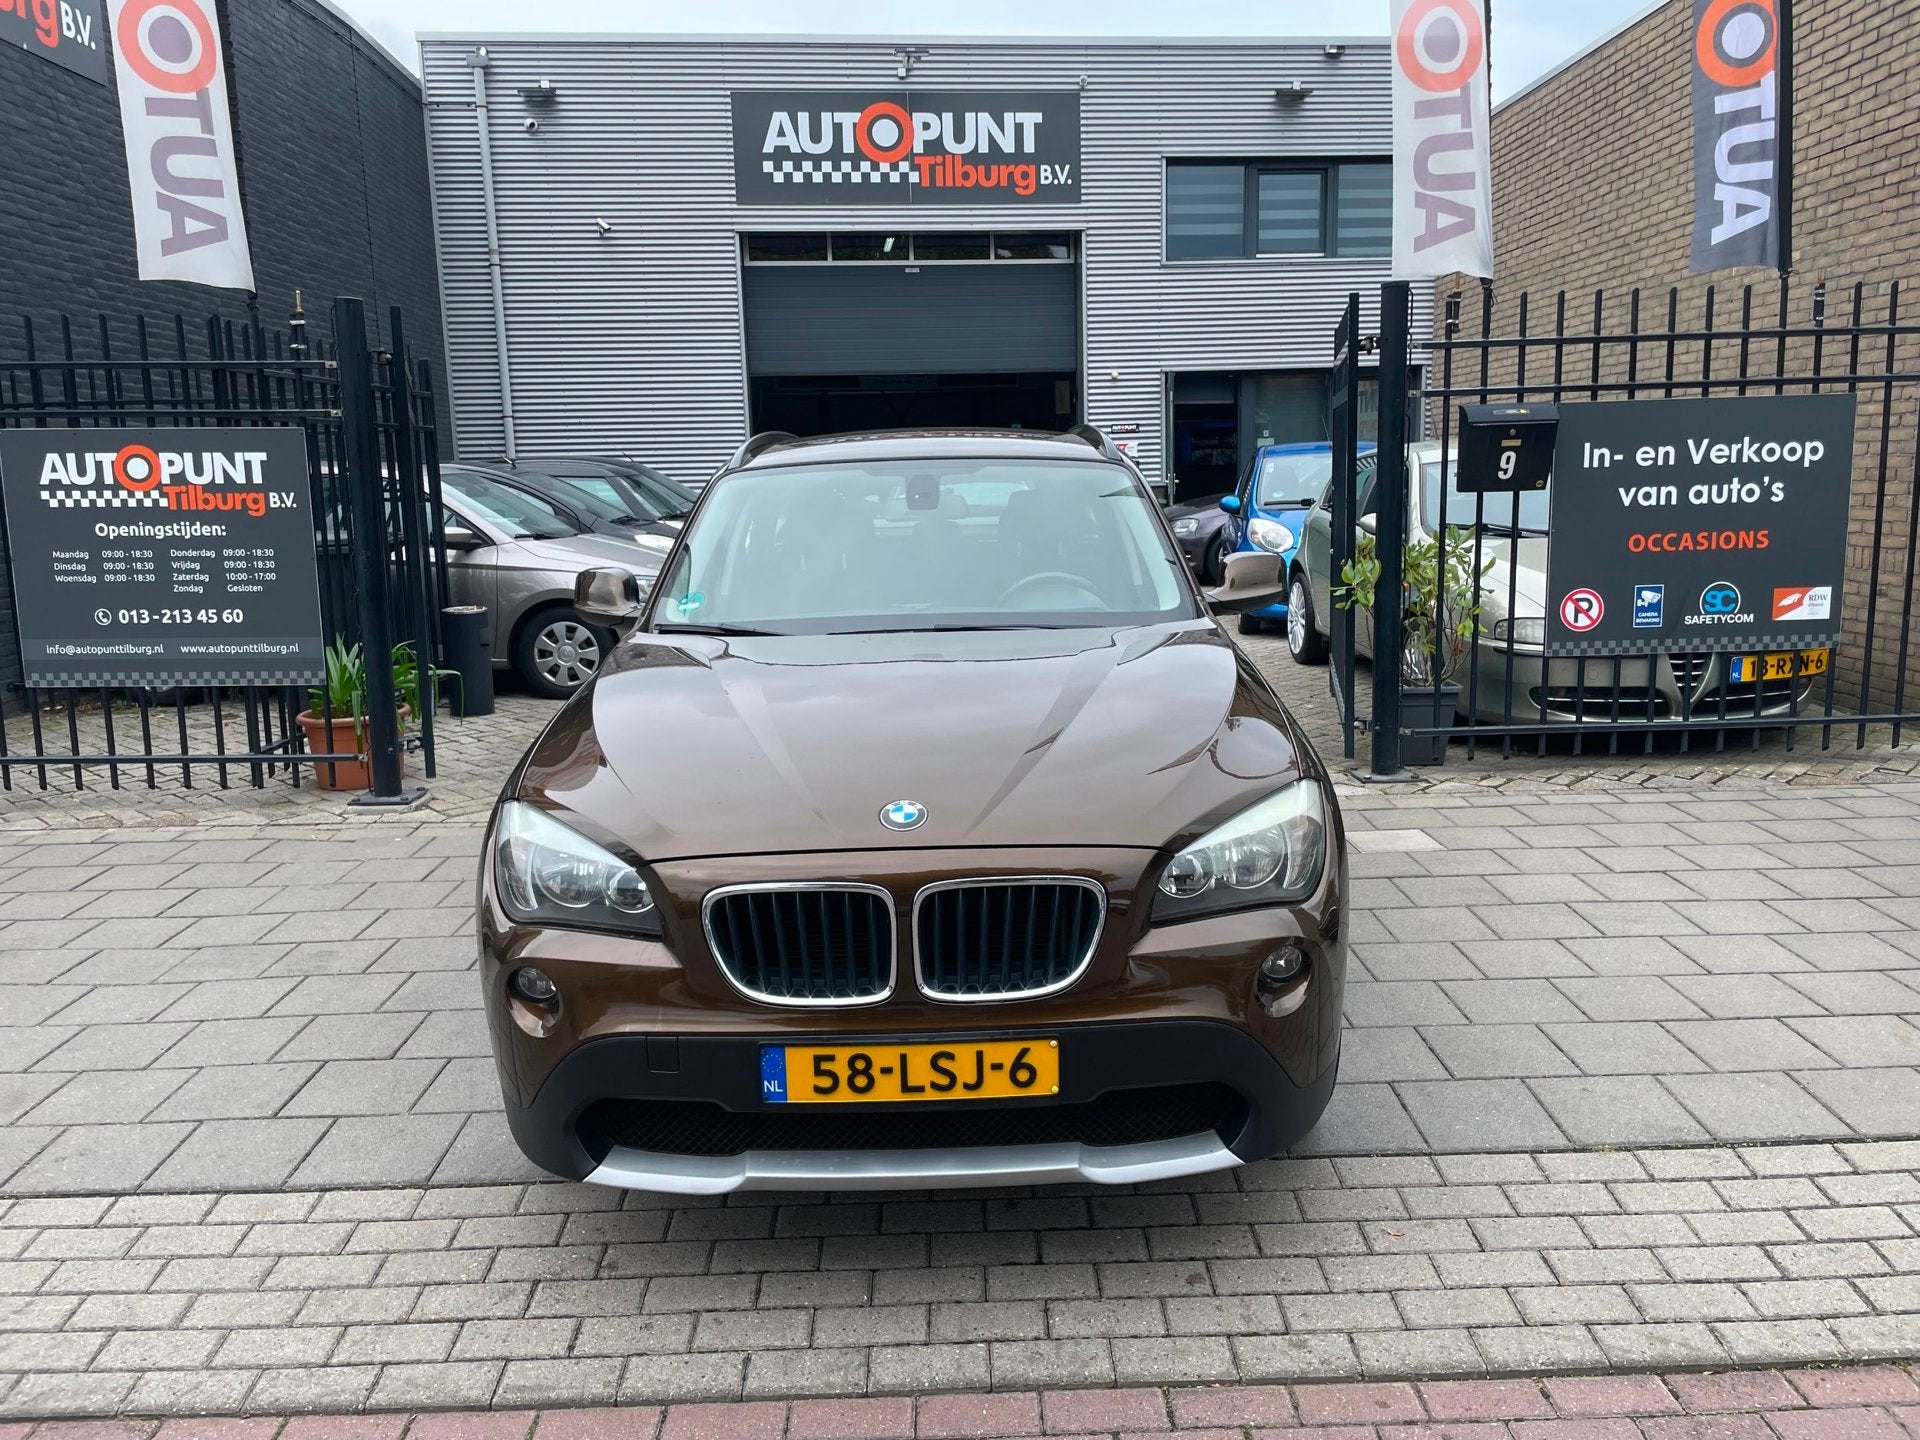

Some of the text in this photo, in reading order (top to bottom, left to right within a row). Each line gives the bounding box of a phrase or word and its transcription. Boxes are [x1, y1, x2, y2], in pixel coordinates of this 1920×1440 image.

[60, 1, 96, 50] B.V.
[762, 101, 1043, 164] AUTOPUNT
[915, 154, 1072, 195] Tilburg B.V.
[1583, 436, 1824, 468] In- en Verkoop
[39, 444, 267, 492] AUTOPUNT
[1498, 451, 1516, 480] 9
[1618, 476, 1784, 507] van auto's
[162, 485, 297, 517] Tilburg B.V.
[95, 522, 227, 539] Openingstijden:
[1628, 530, 1769, 553] OCCASIONS
[52, 550, 89, 559] Maandag
[102, 550, 125, 558] 09:00
[131, 550, 153, 558] 18:30
[170, 549, 216, 559] Donderdag
[223, 549, 246, 557] 09:00
[252, 549, 274, 557] 18:30
[53, 562, 86, 572] Dinsdag
[103, 562, 126, 570] 09:00
[132, 562, 154, 570] 18:30
[171, 561, 200, 570] Vrijdag
[224, 561, 247, 569] 09:00
[253, 561, 275, 569] 18:30
[54, 574, 97, 584] Woensdag
[104, 574, 127, 582] 09:00
[133, 574, 155, 582] 18:30
[172, 573, 209, 582] Zaterdag
[226, 573, 248, 581] 10:00
[254, 572, 276, 580] 17:00
[173, 584, 263, 594] Zondag Gesloten
[1704, 590, 1736, 612] SC
[1808, 594, 1829, 602] RDW
[196, 609, 218, 623] 45
[222, 608, 244, 623] 60
[1684, 613, 1754, 625] SAFETYCOM
[46, 644, 164, 656] info@autopunttilburg.nl
[180, 643, 299, 655] www.autopunttilburg.nl
[763, 1047, 1038, 1095] NL 58-LSJ-6
